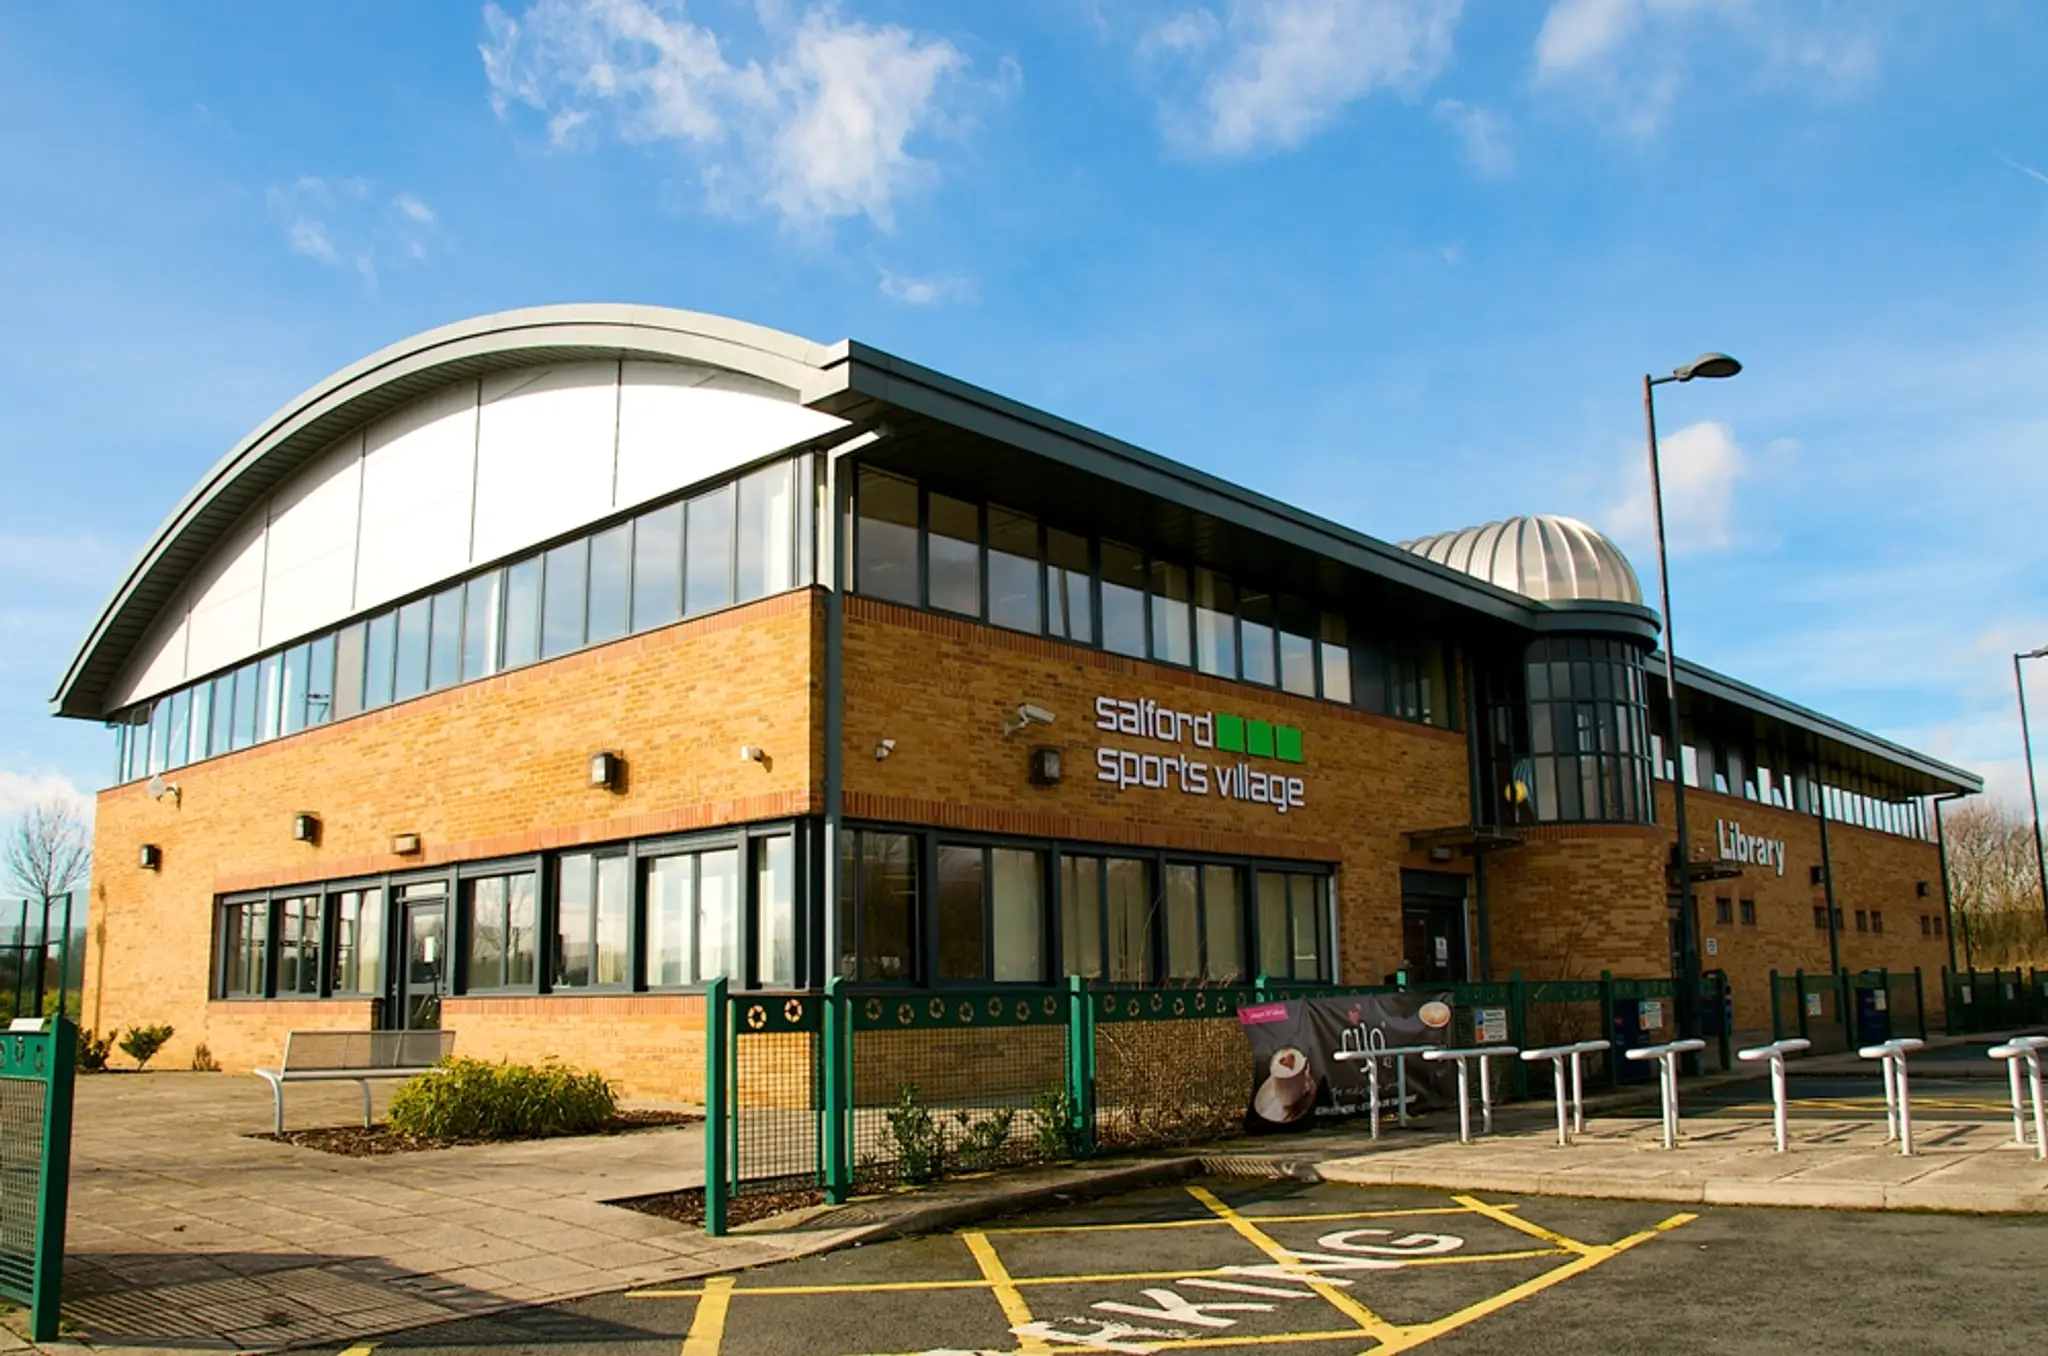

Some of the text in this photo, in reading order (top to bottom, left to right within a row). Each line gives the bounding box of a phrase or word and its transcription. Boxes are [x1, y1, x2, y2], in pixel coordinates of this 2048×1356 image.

[1096, 697, 1214, 749] salford
[1097, 748, 1305, 813] sports village
[1718, 819, 1785, 876] Library
